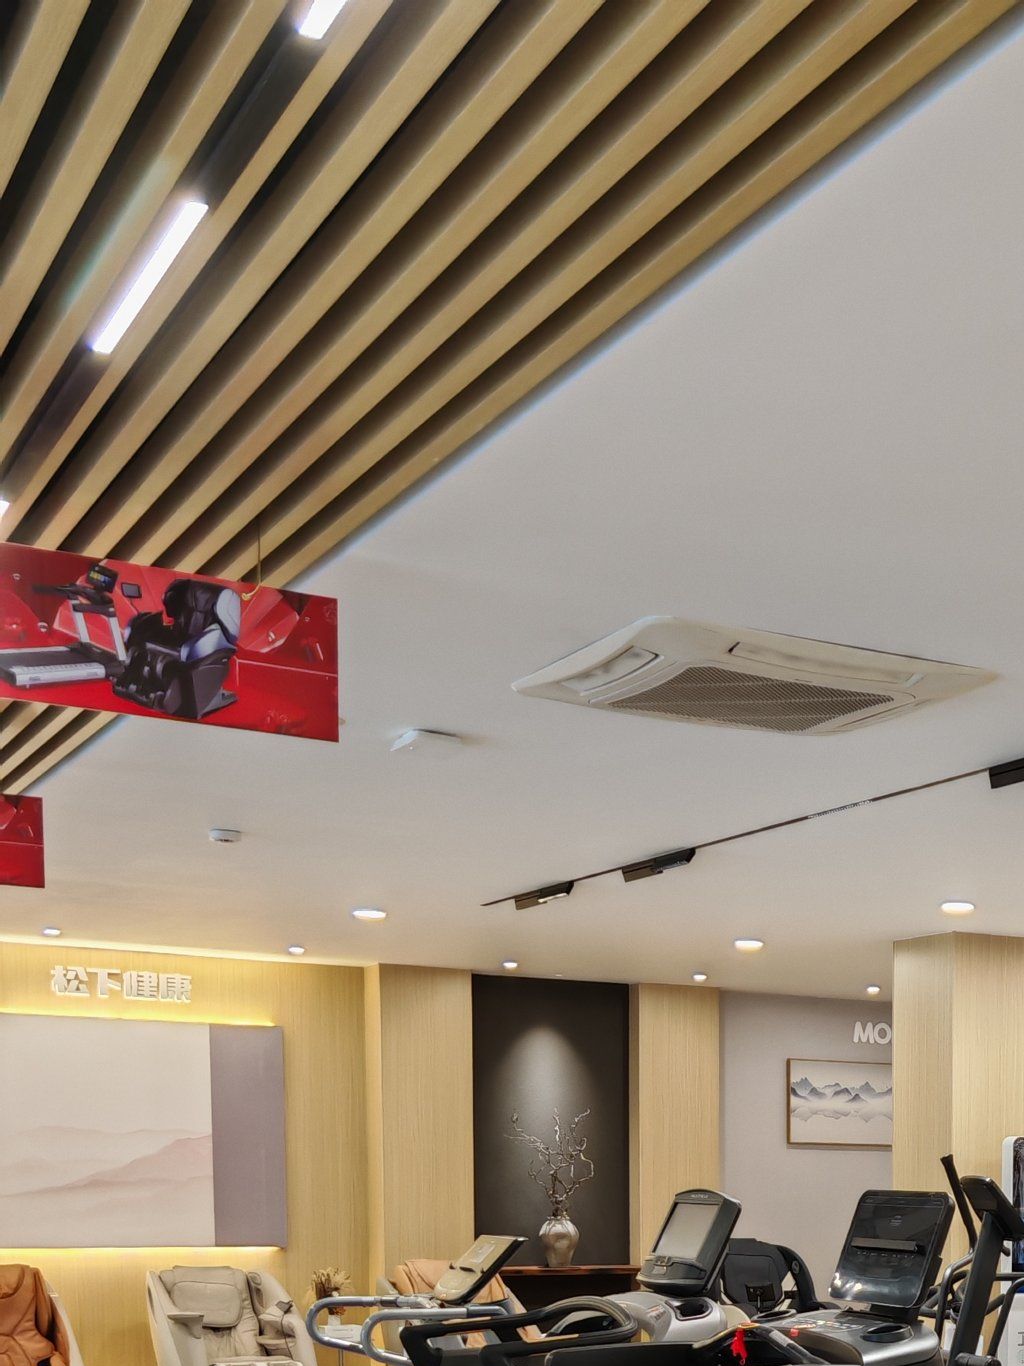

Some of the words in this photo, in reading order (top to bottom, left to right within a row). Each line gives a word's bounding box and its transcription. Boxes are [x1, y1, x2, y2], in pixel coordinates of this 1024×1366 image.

[50, 965, 192, 1003] 松下健康
[853, 1021, 892, 1044] MO
